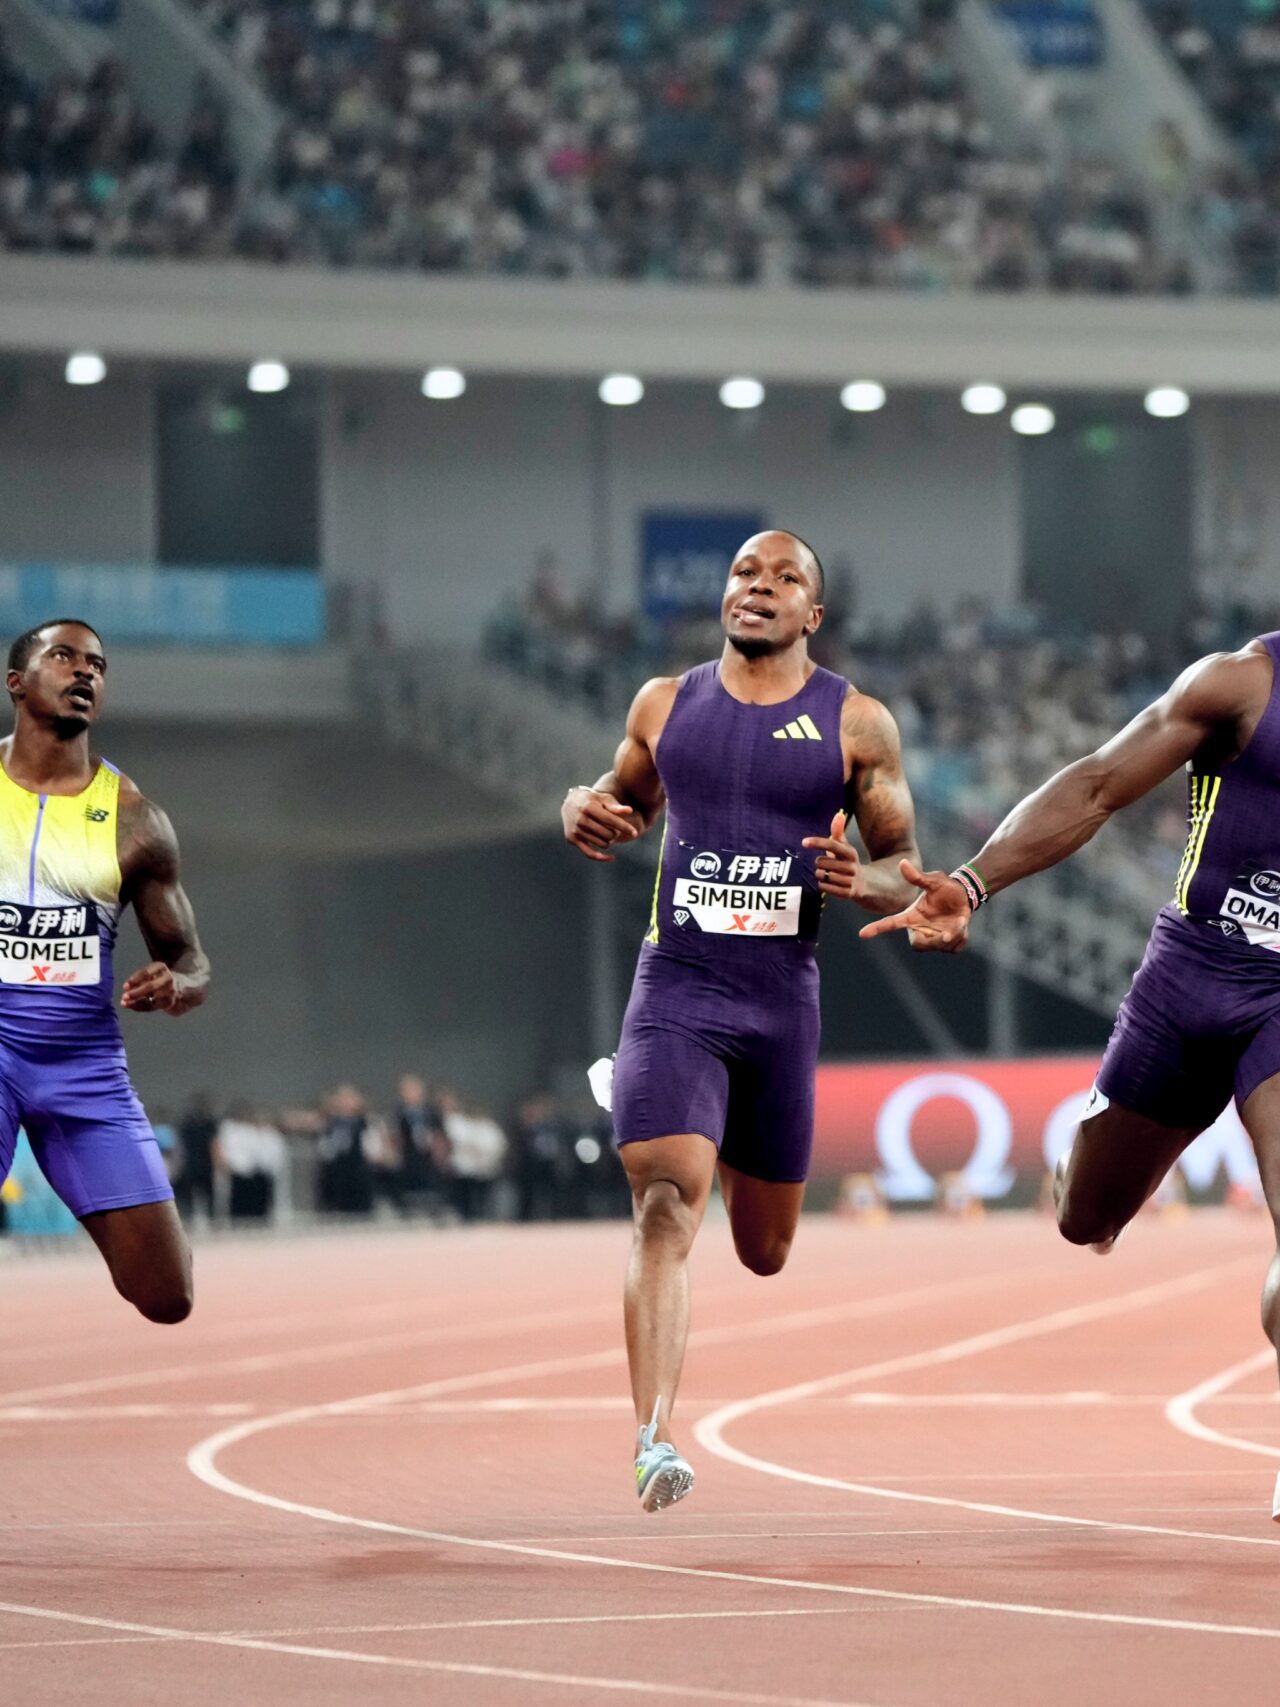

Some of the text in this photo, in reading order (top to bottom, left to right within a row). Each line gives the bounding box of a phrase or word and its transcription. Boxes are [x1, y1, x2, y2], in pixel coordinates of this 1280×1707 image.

[728, 855, 792, 884] 伊利
[686, 885, 788, 911] SIMBINE
[28, 907, 87, 936] 伊利
